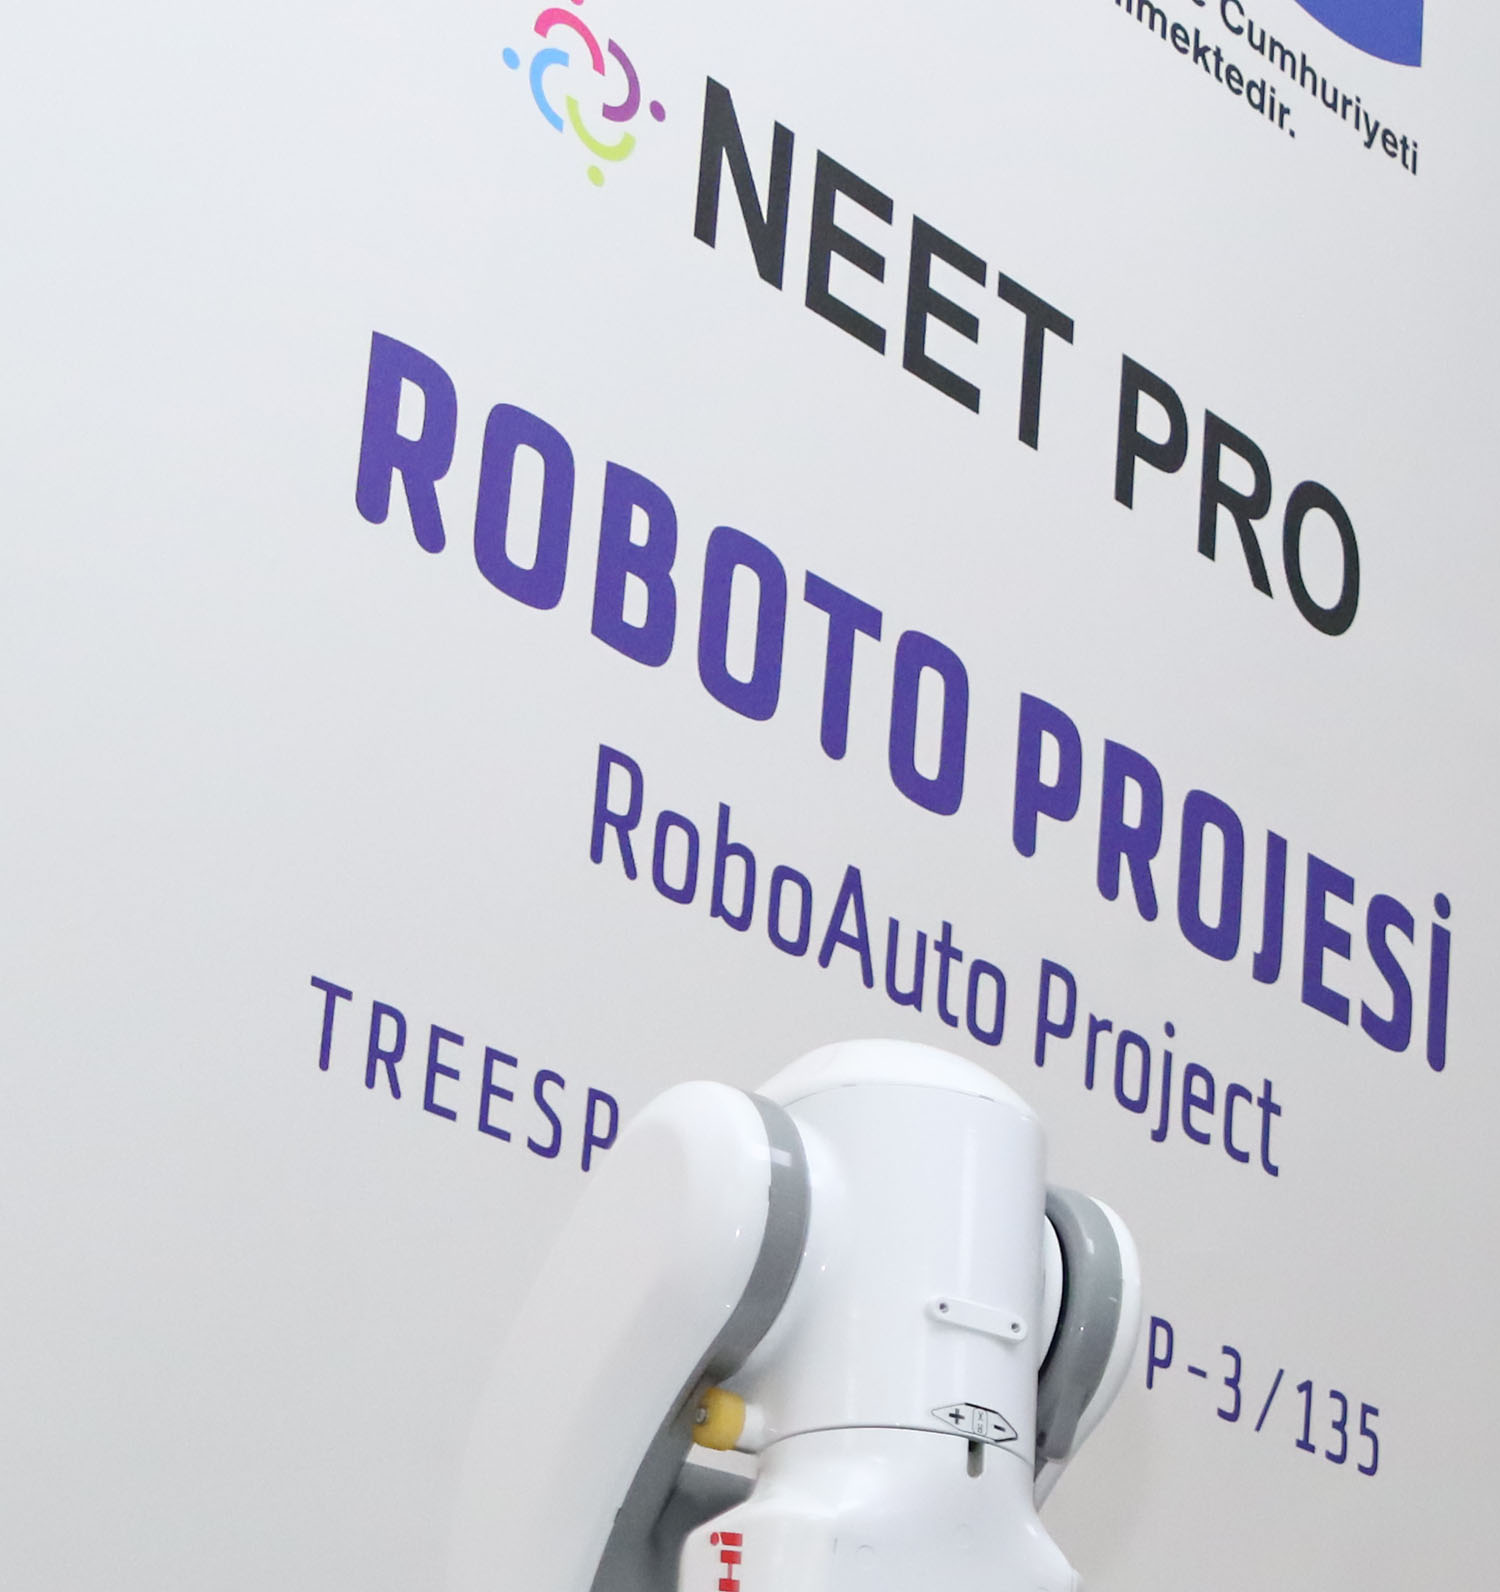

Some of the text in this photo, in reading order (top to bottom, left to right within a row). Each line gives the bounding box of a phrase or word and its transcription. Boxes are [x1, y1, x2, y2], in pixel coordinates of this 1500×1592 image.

[1220, 0, 1419, 176] Cumhuriyeti
[354, 330, 969, 817] ROBOTO
[693, 76, 1361, 637] NEET PRO
[590, 743, 1282, 1178] RoboAuto Project
